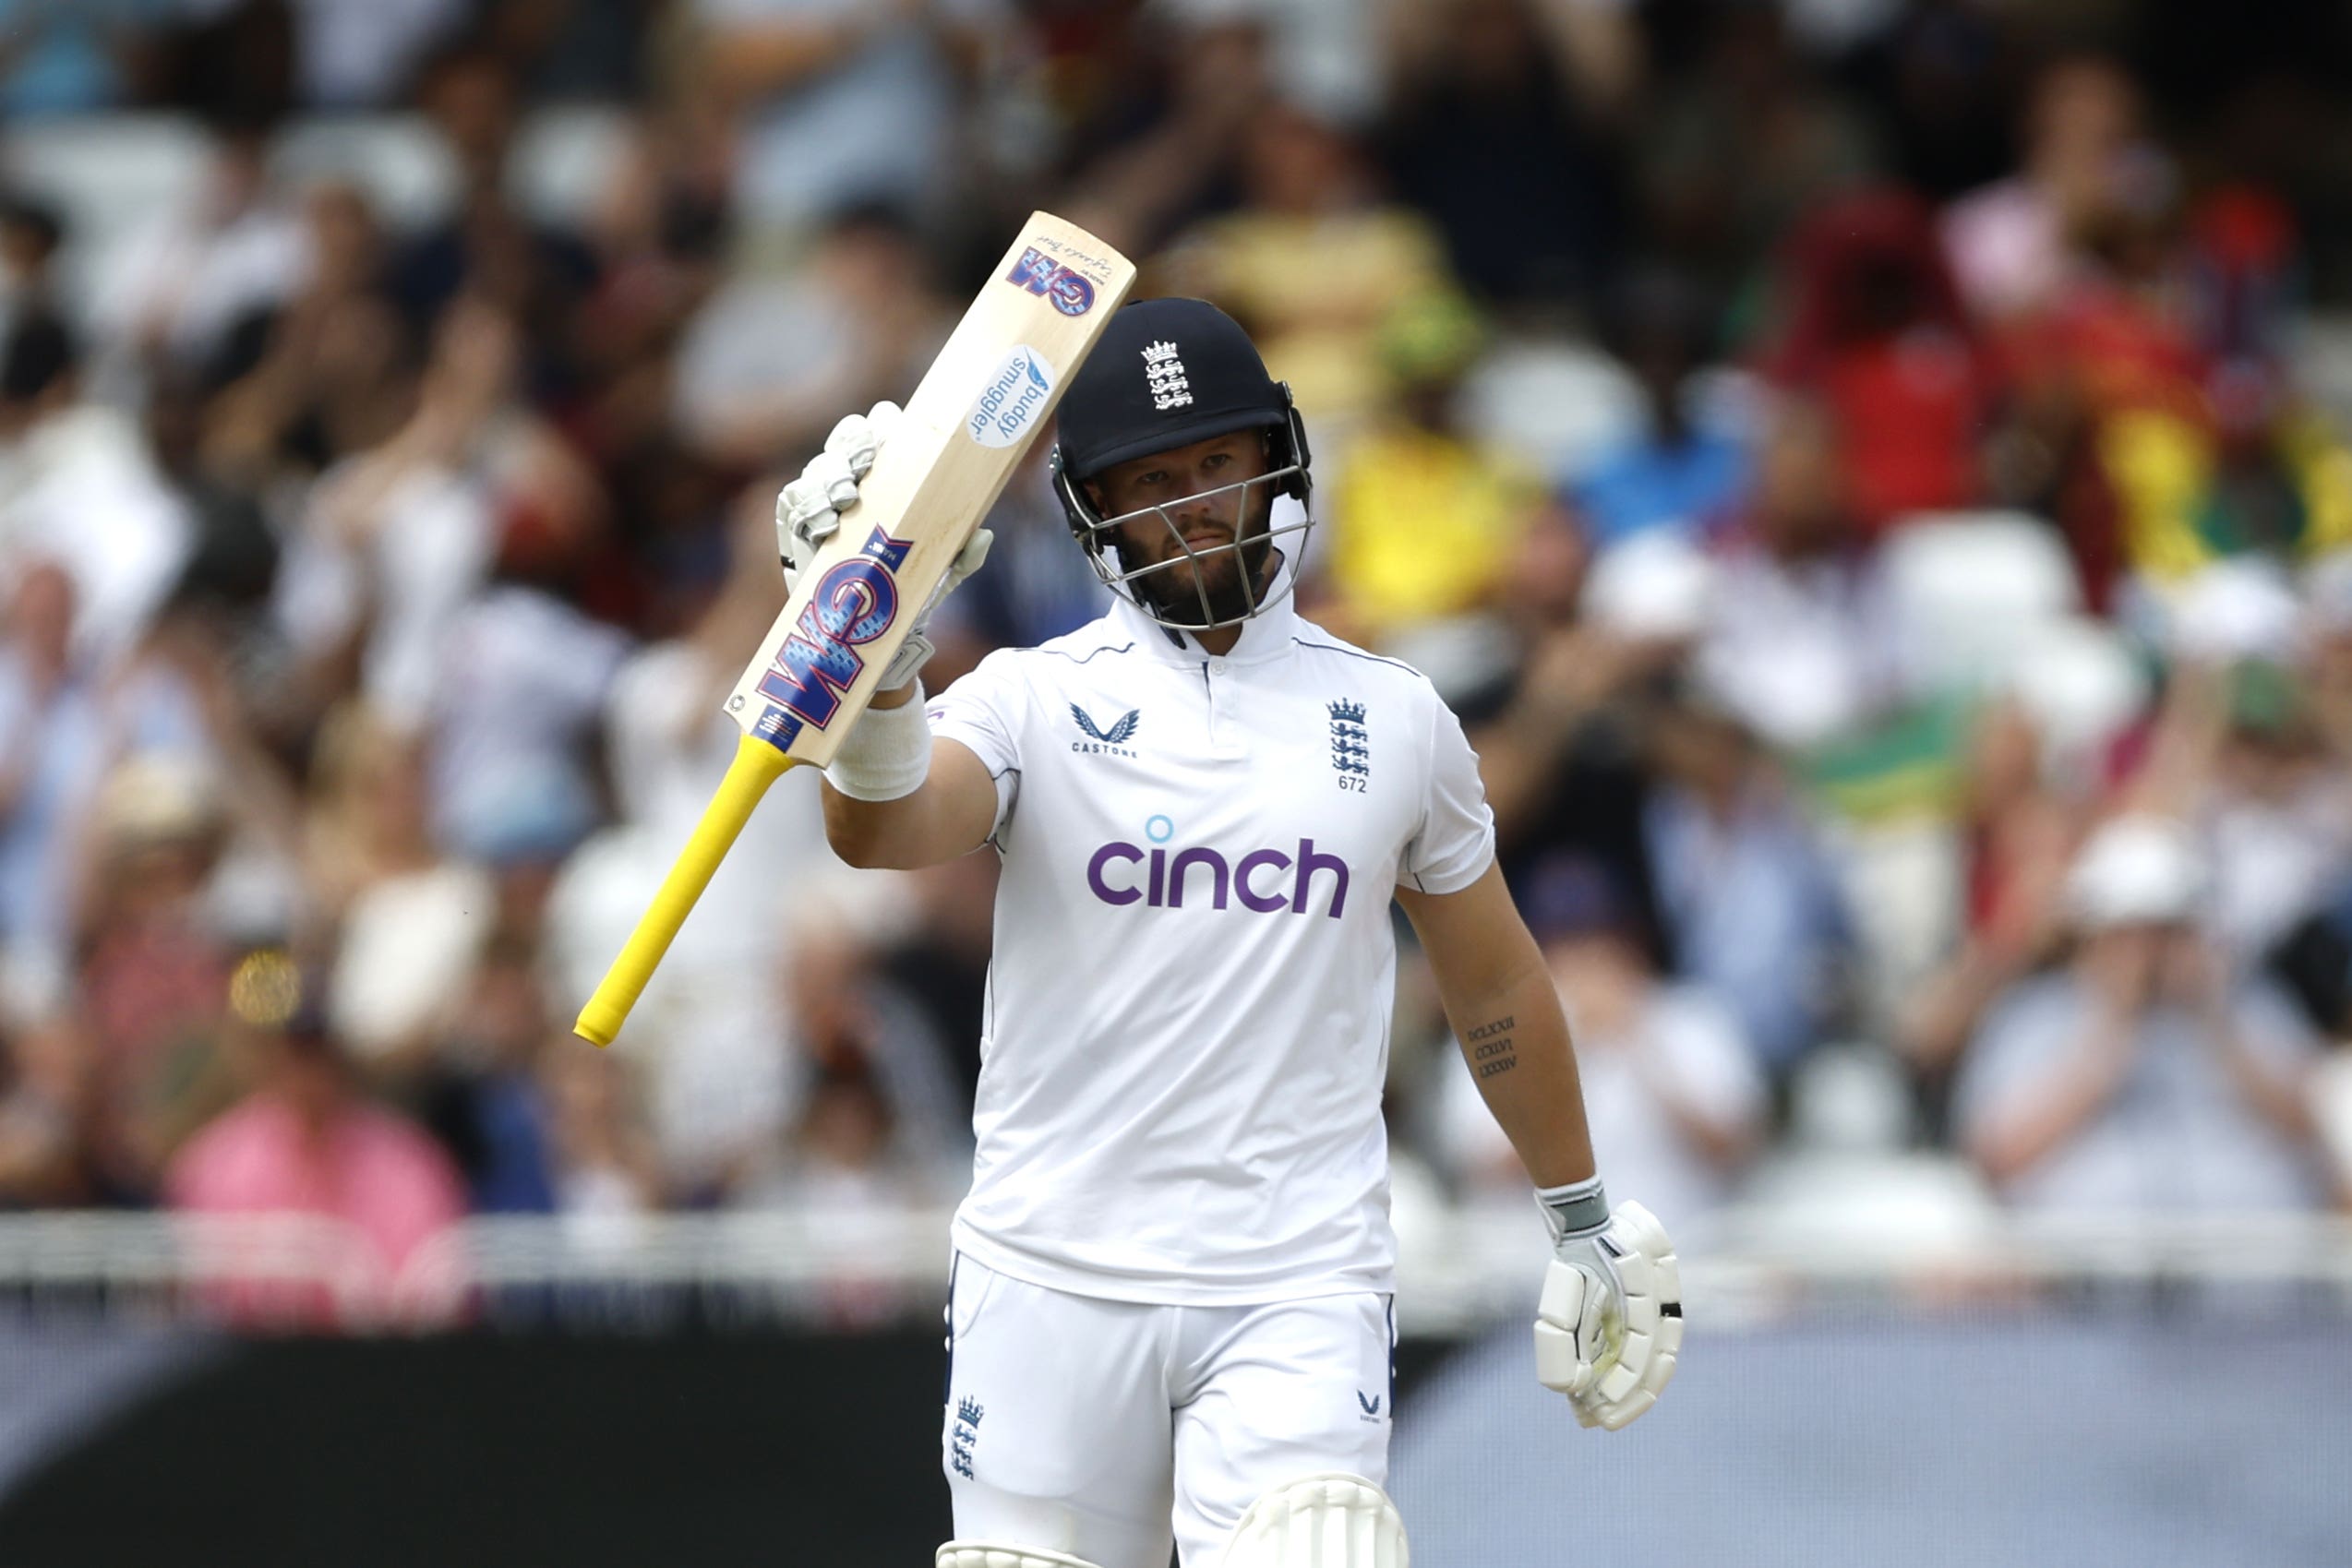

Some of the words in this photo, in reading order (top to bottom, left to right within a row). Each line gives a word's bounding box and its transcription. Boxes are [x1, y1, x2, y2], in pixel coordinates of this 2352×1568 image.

[1005, 245, 1096, 317] GM
[970, 357, 1026, 435] smuggler
[997, 384, 1044, 439] budgy
[754, 557, 899, 732] GM
[1072, 742, 1137, 759] CASTORE
[1338, 775, 1366, 794] 672
[1086, 814, 1350, 919] cinch
